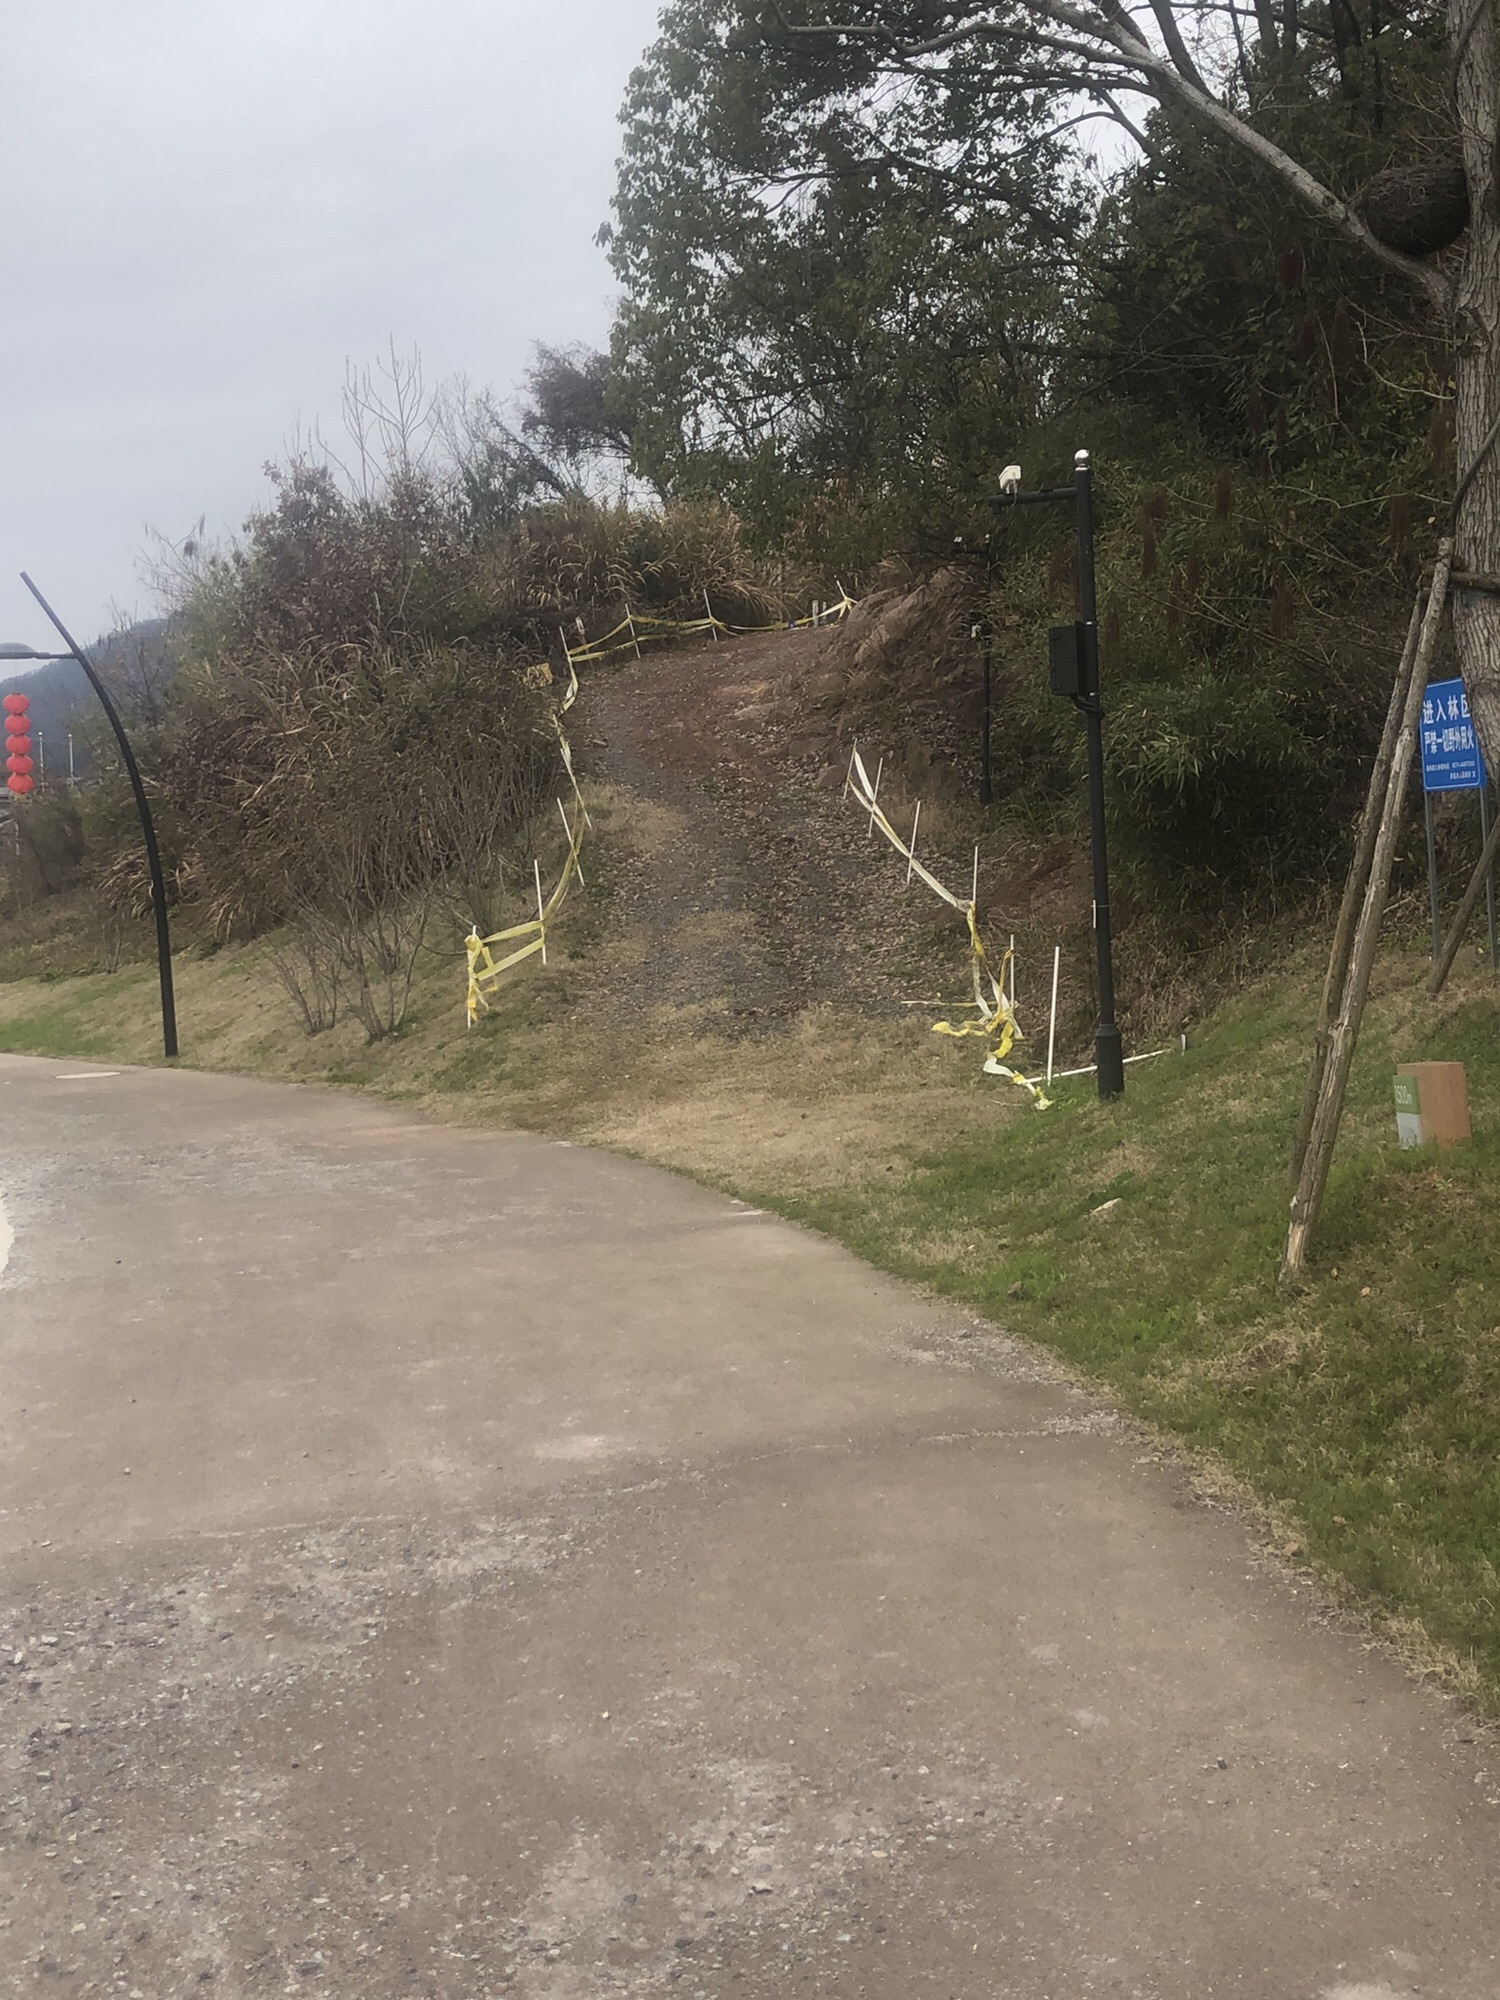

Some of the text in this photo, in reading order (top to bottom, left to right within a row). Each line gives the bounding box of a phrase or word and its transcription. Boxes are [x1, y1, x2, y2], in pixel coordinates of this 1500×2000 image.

[1423, 694, 1470, 724] 进入林区
[1424, 725, 1474, 754] 严禁一切野外用火
